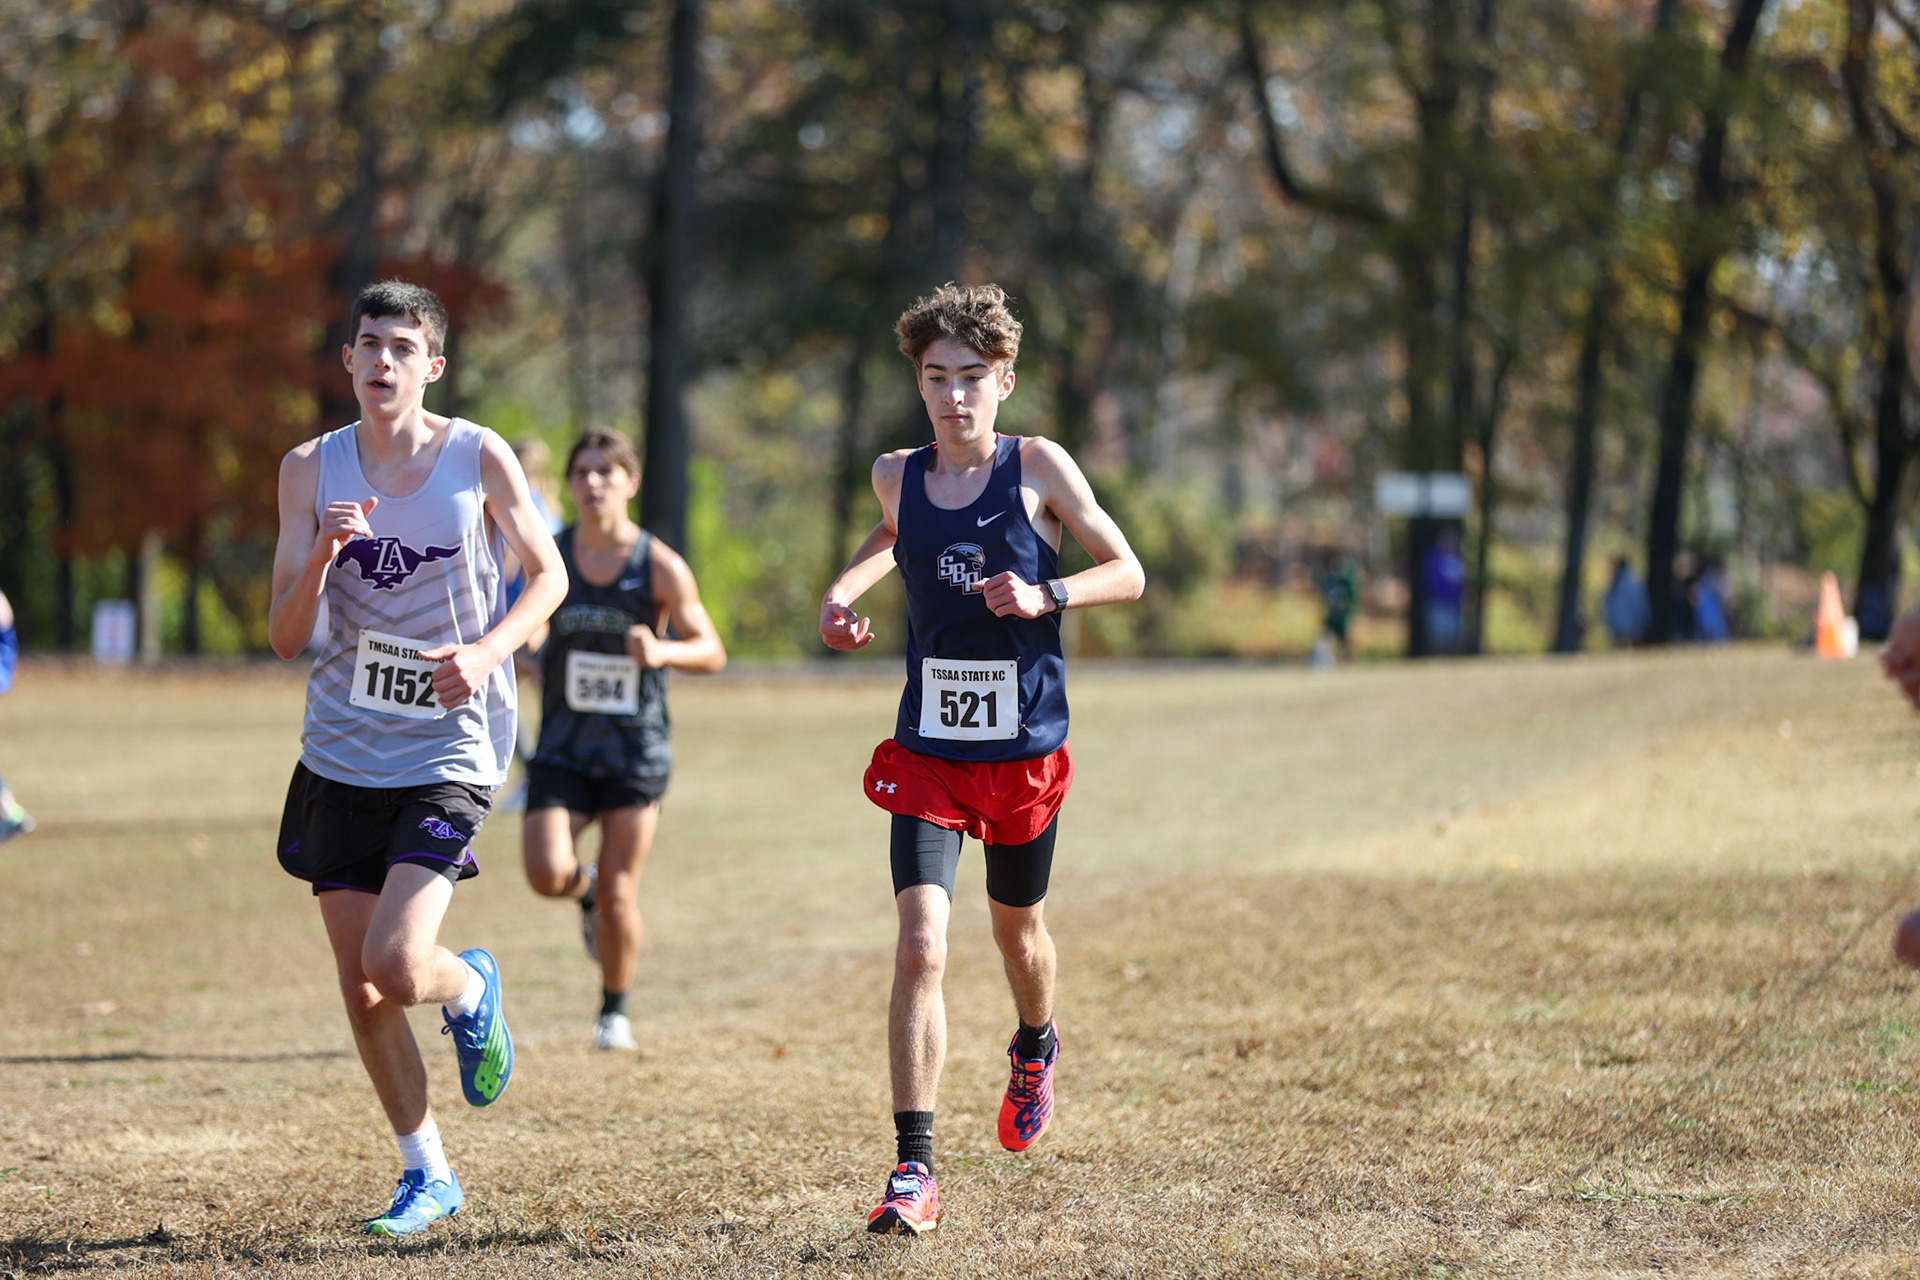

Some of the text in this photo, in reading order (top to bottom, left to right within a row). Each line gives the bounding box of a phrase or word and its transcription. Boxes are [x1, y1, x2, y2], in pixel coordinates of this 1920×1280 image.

[372, 539, 411, 574] LA
[368, 640, 399, 658] TMSAA
[365, 661, 436, 708] 1152
[931, 668, 1006, 682] TSSAA STATE XC
[940, 689, 998, 728] 521
